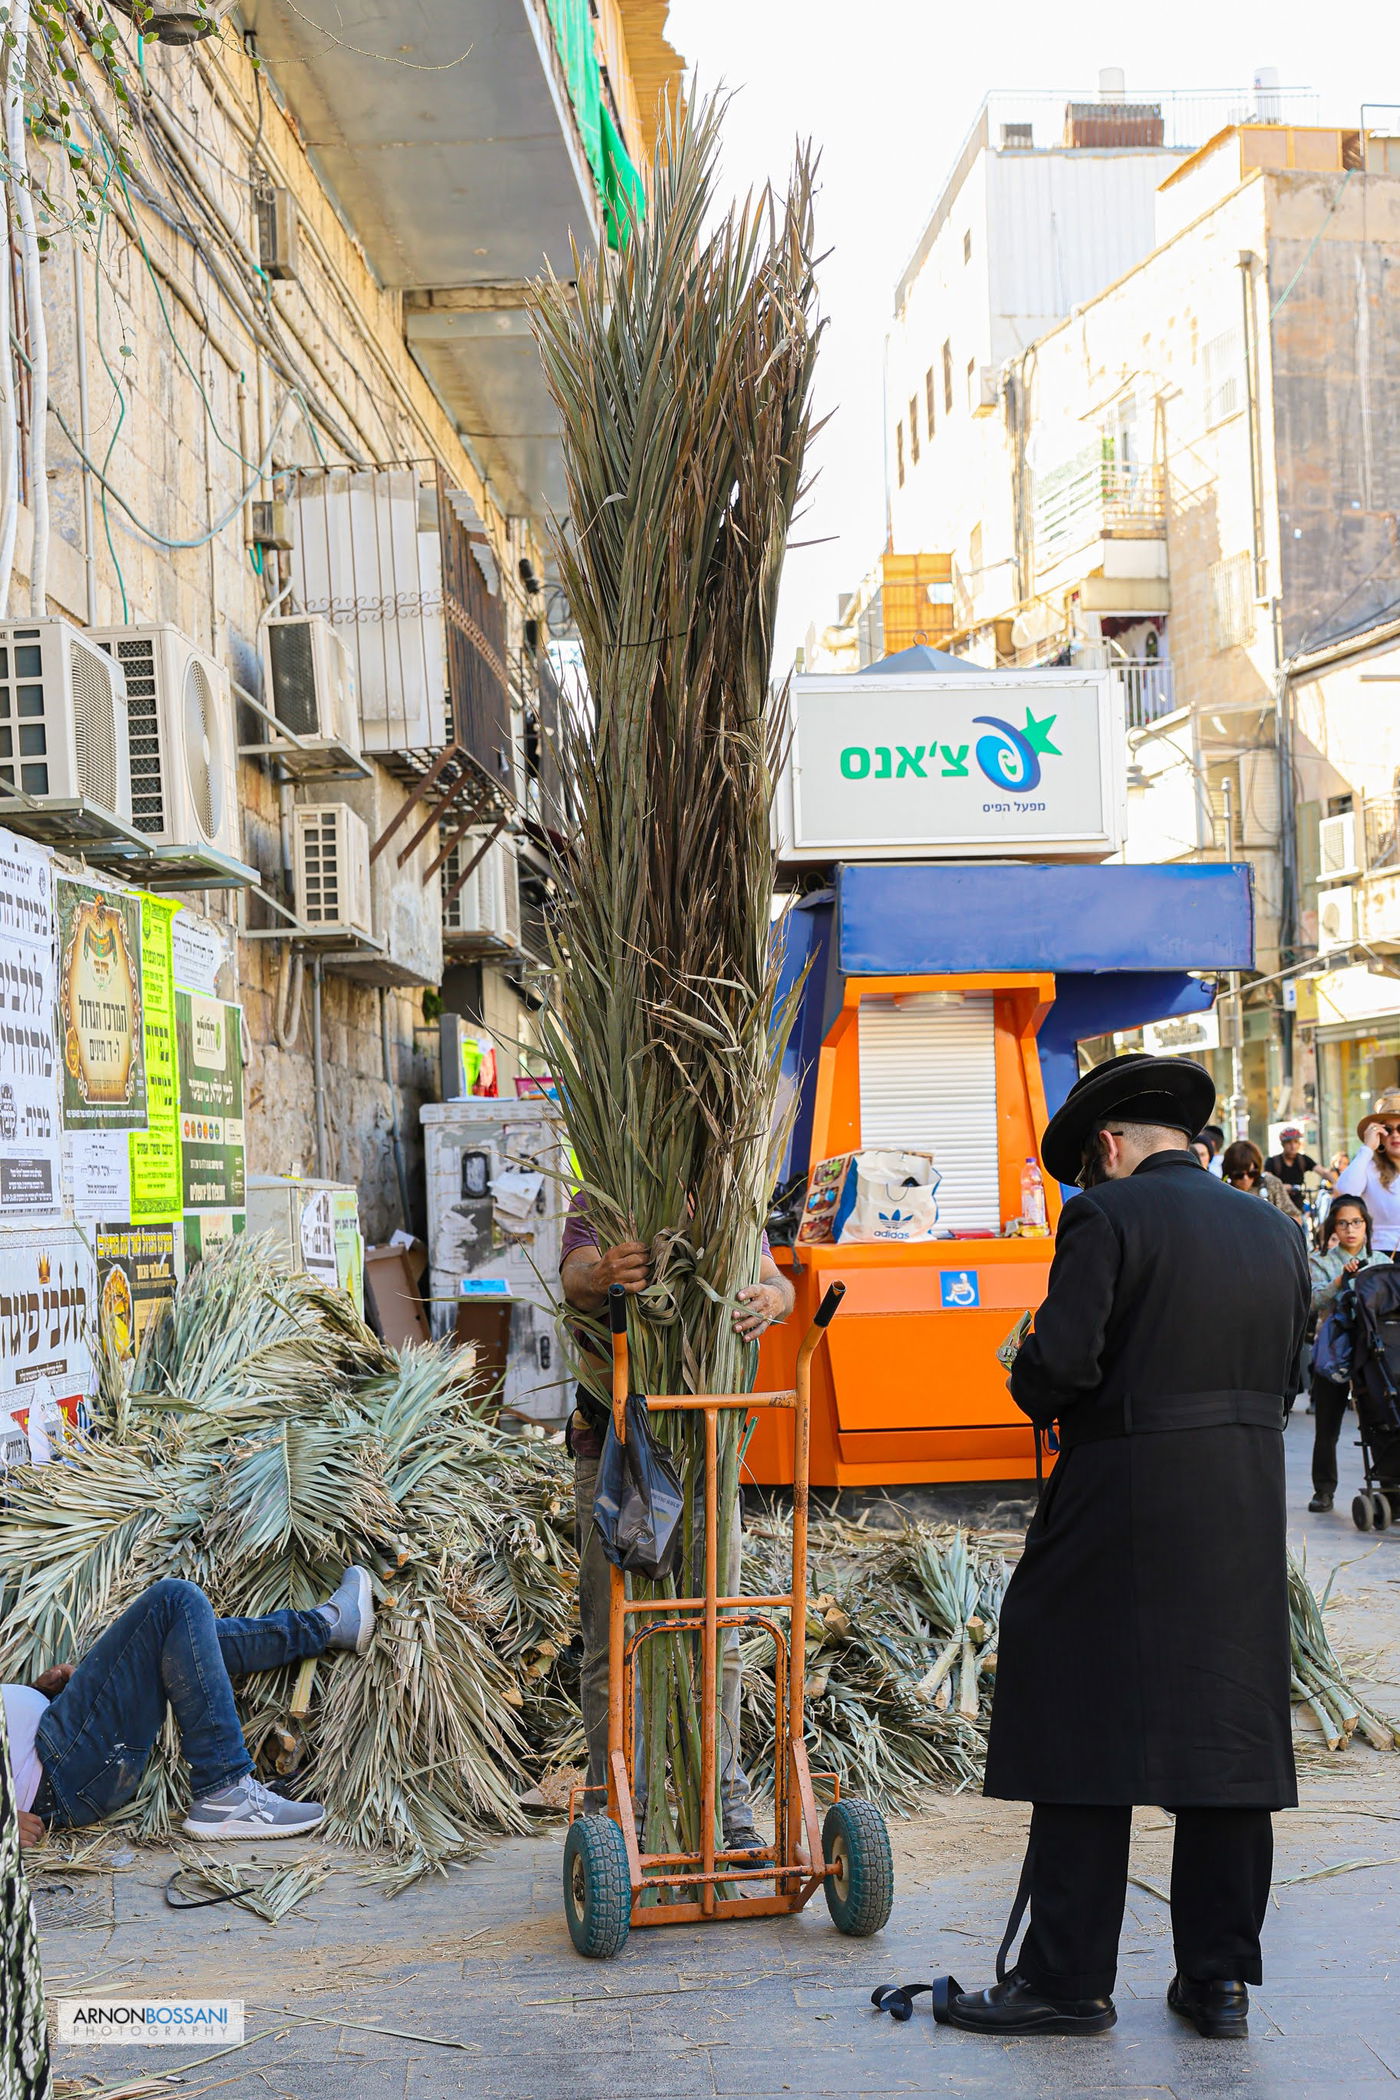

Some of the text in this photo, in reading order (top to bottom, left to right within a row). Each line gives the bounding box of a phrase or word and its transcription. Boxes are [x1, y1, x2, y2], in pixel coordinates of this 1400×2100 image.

[840, 740, 970, 780] צ'אנס
[982, 800, 1046, 813] מפעל הפיס
[78, 994, 128, 1033] המרכז הגדול
[0, 1020, 52, 1078] מהודרי
[873, 1229, 910, 1240] adidas
